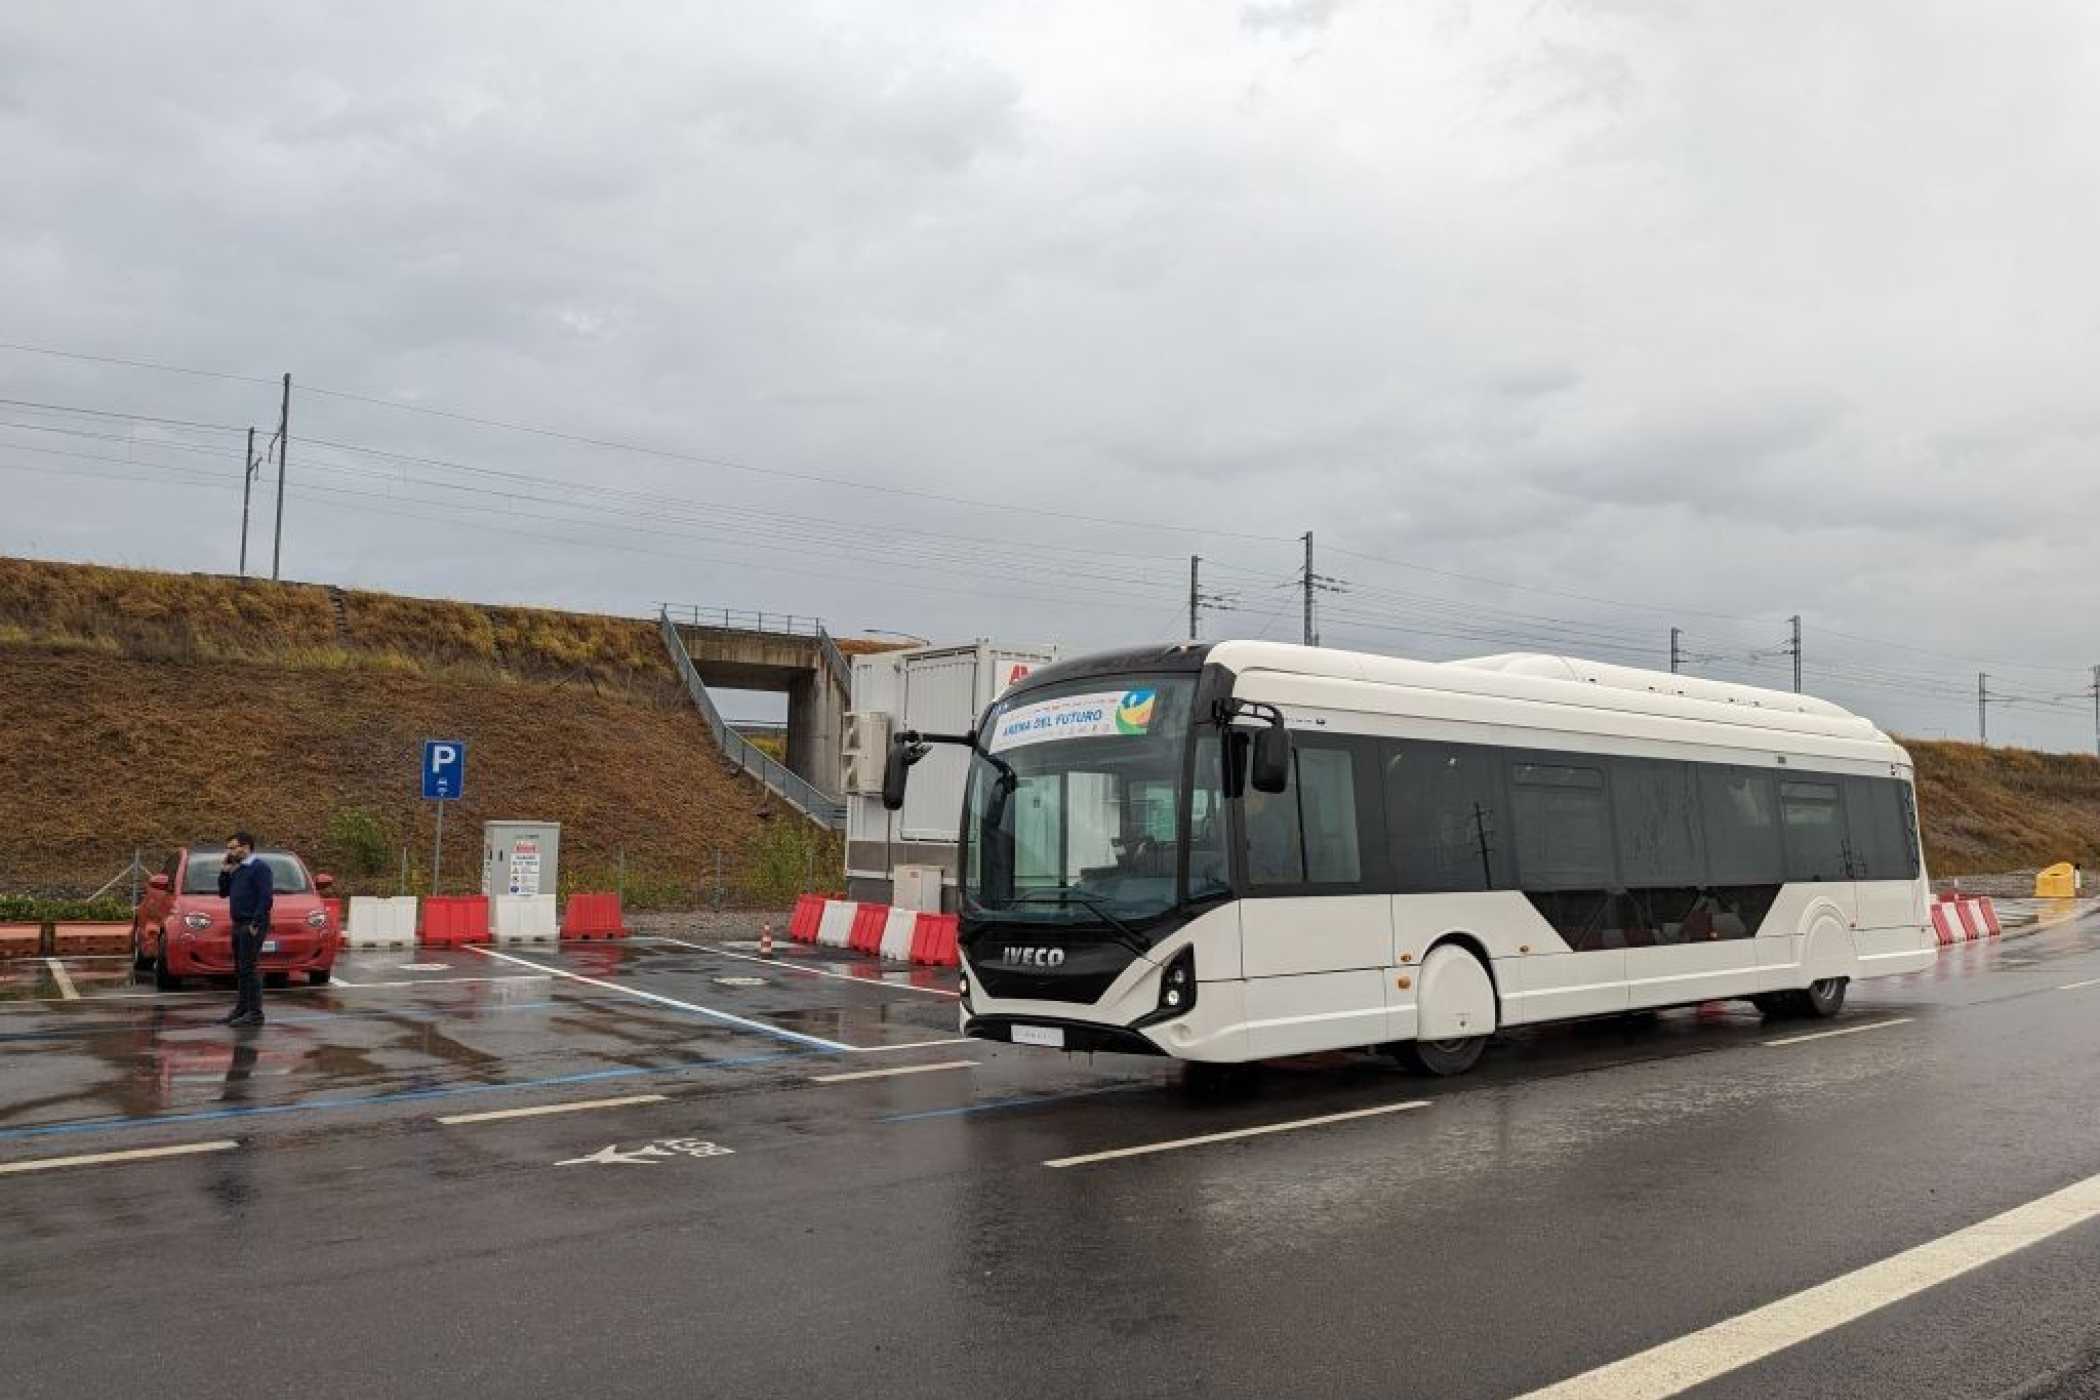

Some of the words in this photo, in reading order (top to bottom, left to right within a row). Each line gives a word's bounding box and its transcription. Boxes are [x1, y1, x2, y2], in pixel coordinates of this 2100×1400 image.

[1034, 715, 1051, 728] DEL
[1056, 709, 1102, 725] FUTURO
[433, 745, 456, 773] P
[1003, 947, 1064, 966] IVECO
